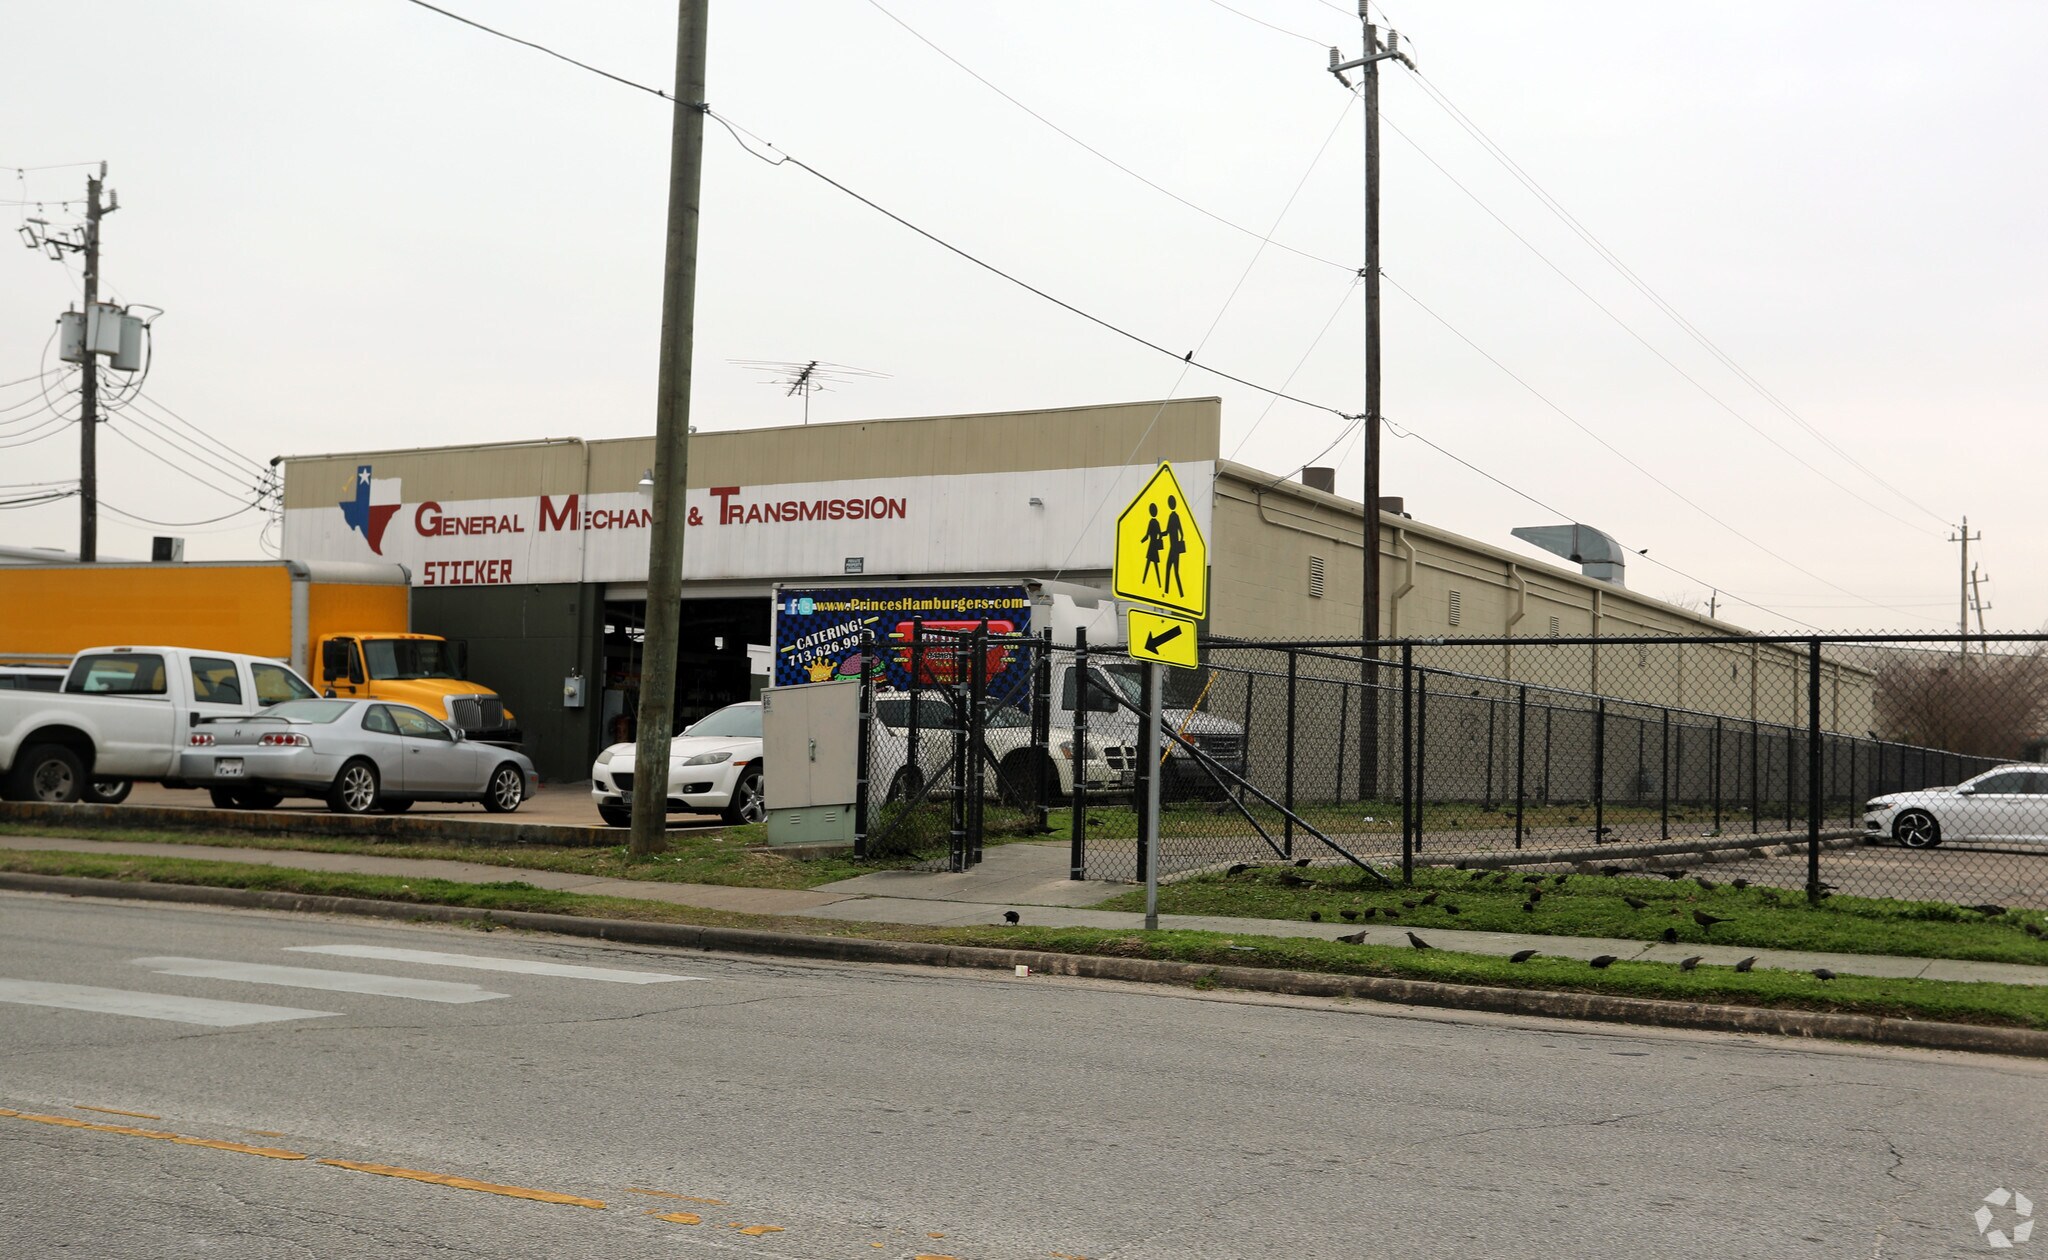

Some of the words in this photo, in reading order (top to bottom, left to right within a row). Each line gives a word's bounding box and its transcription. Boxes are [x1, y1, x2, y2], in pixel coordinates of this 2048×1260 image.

[414, 500, 525, 538] GENERAL
[538, 493, 654, 532] MECHAN
[686, 506, 704, 527] &
[709, 486, 907, 526] TRANSMISSION
[423, 559, 513, 585] STICKER
[815, 596, 1024, 613] www.PrincesHamburgers.com
[796, 618, 863, 651] CATERING!
